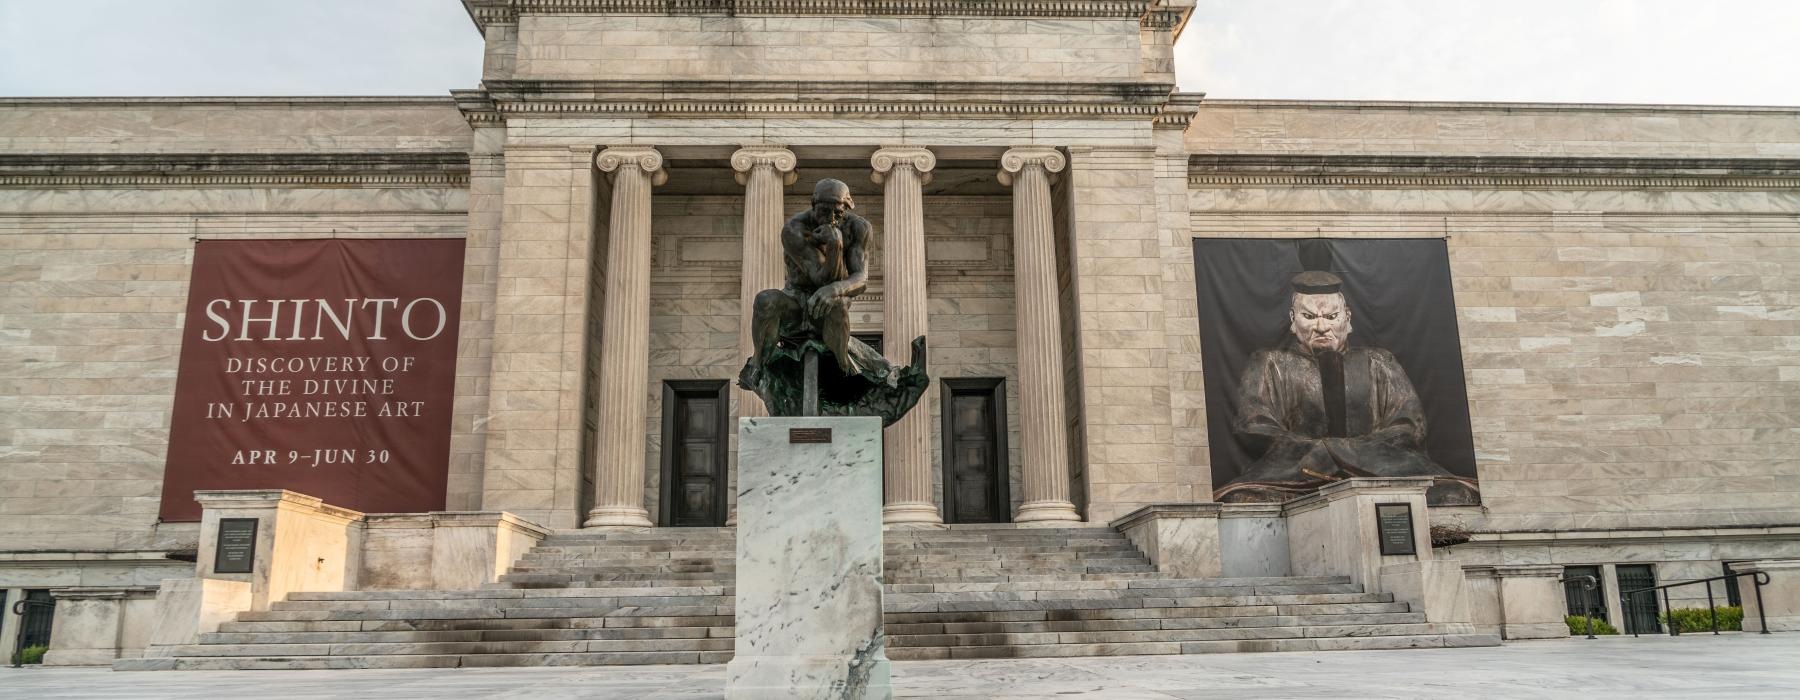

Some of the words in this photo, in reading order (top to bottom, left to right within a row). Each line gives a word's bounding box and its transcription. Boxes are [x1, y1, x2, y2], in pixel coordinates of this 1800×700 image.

[202, 297, 447, 342] SHINTO
[225, 356, 370, 374] DISCOVERY
[382, 356, 415, 372] OF
[241, 379, 291, 396] THE
[302, 378, 394, 395] DIVINE
[206, 402, 234, 419] IN
[241, 401, 367, 423] JAPANESE
[377, 401, 425, 417] ART
[231, 449, 277, 465] APR
[365, 449, 390, 464] 30
